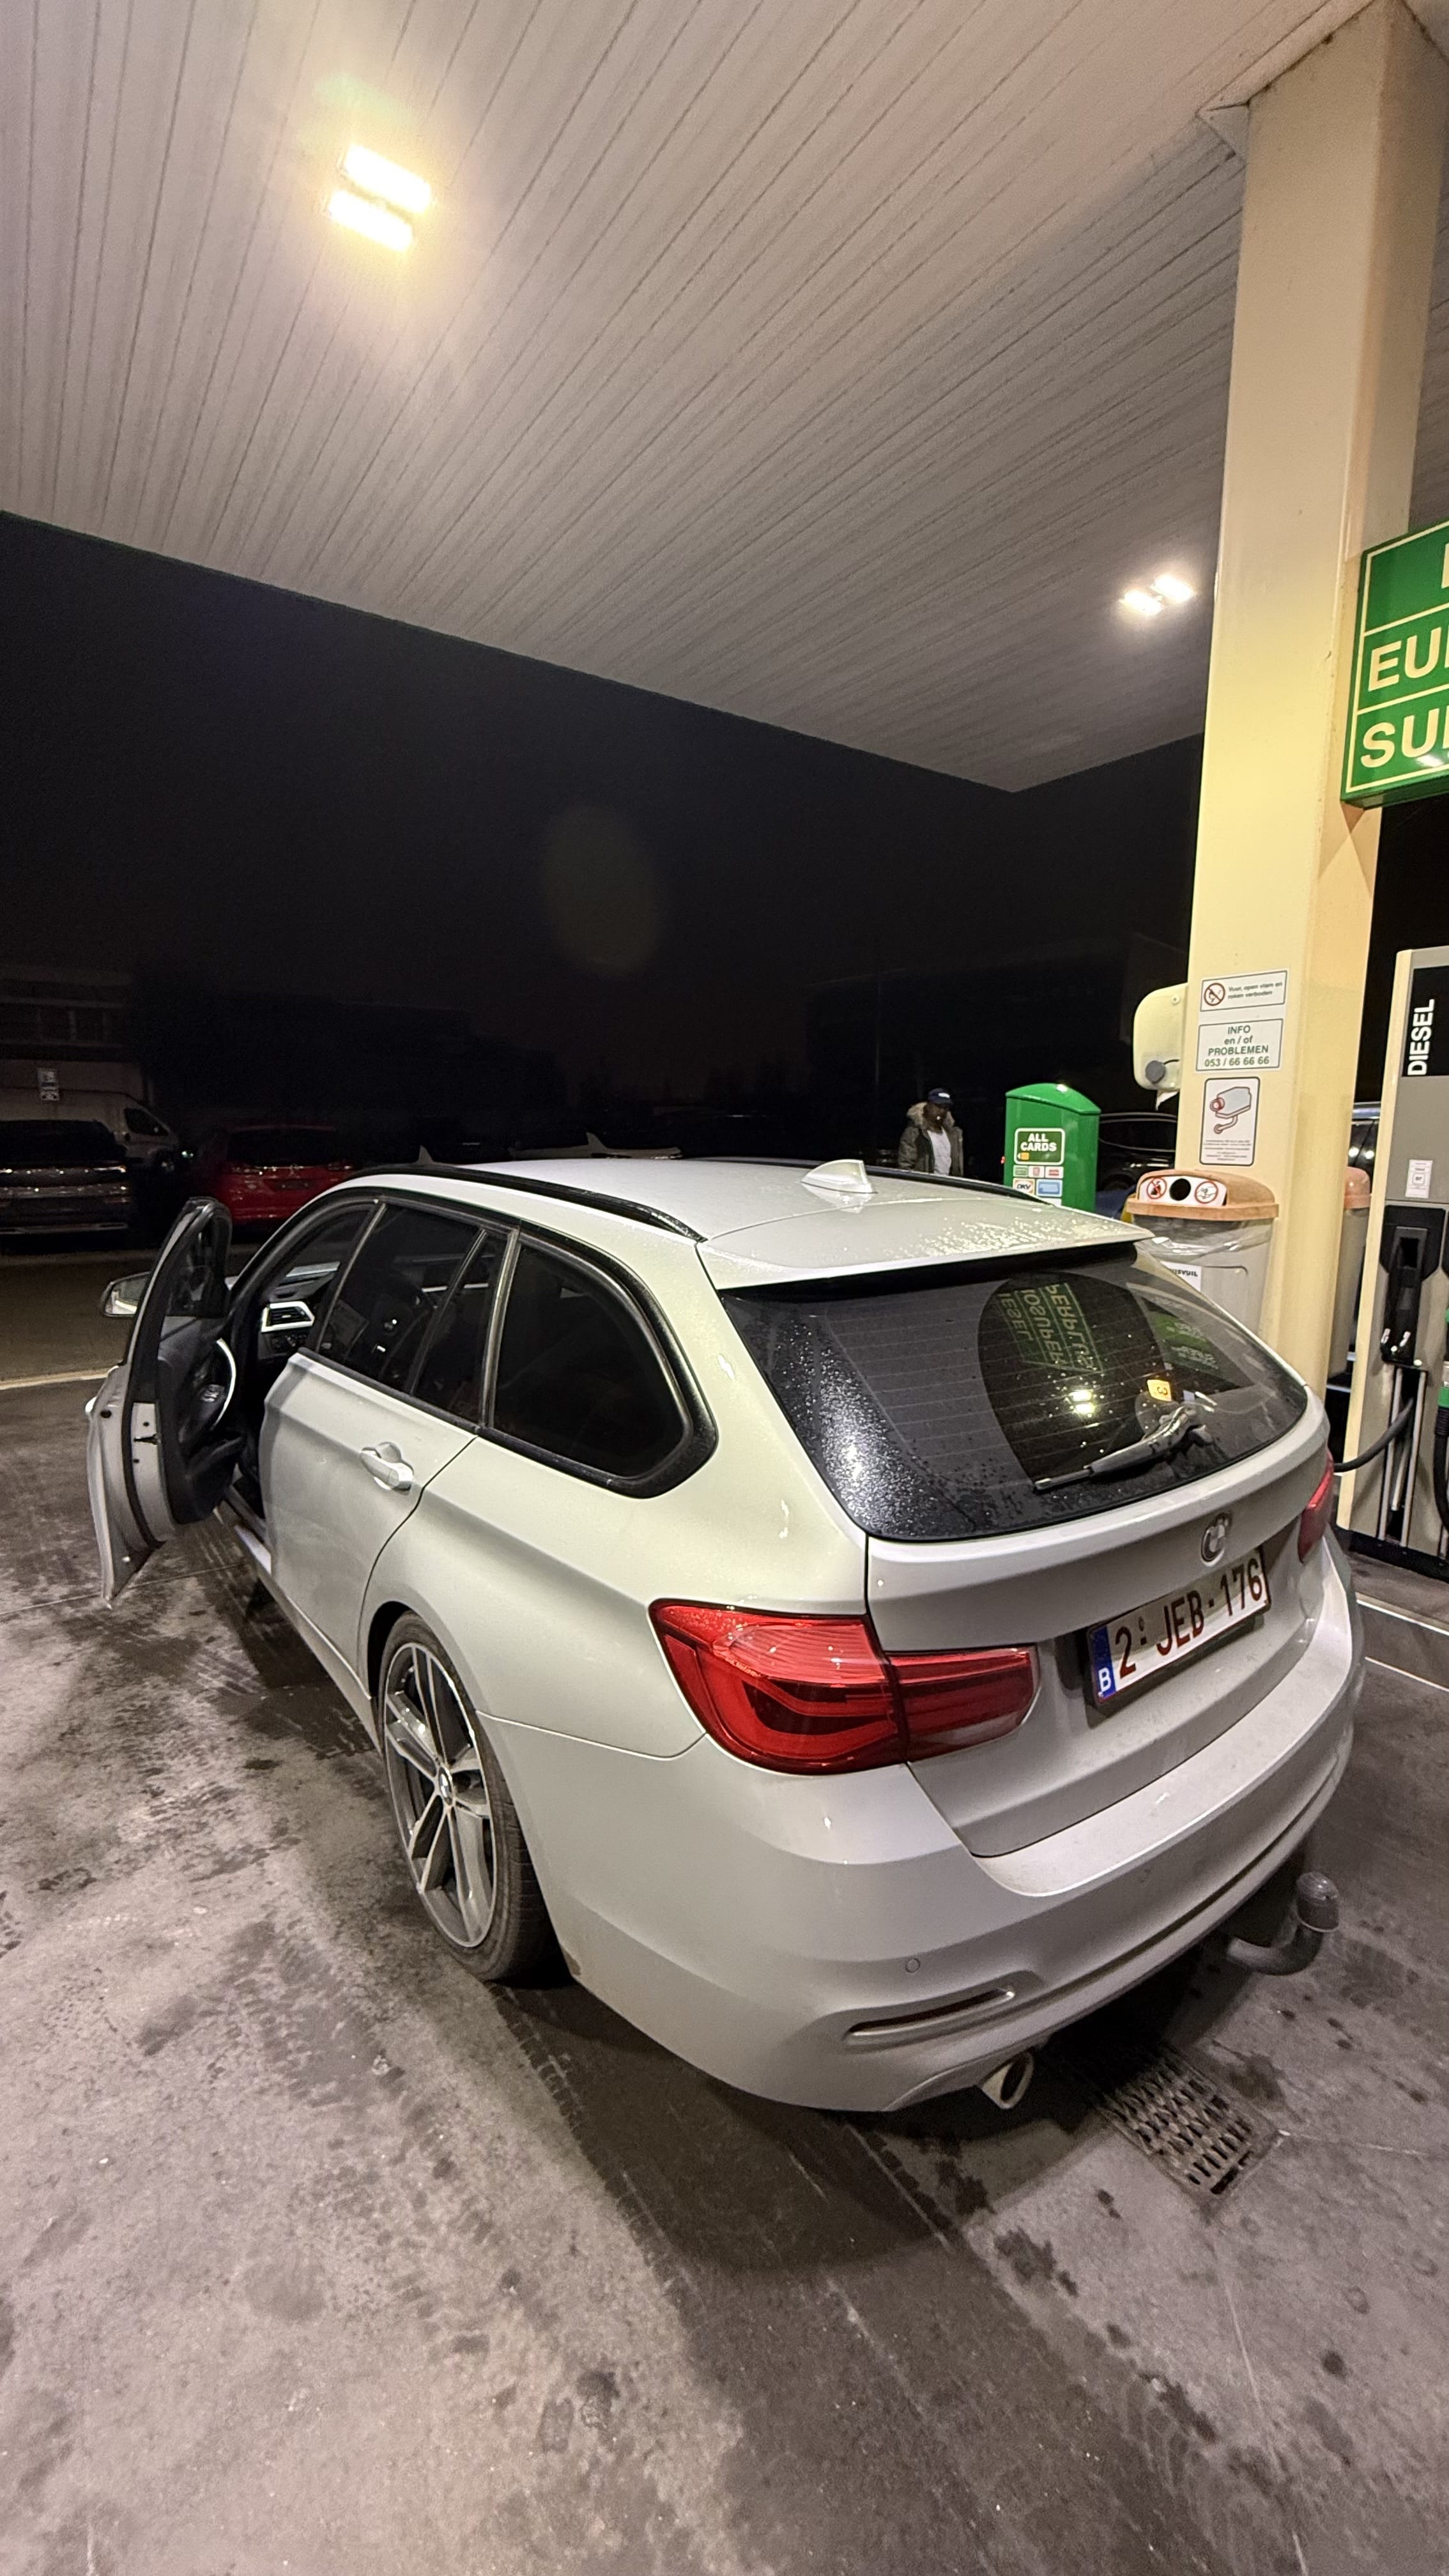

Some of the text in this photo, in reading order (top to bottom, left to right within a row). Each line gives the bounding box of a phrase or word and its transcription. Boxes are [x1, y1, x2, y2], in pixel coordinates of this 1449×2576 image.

[1368, 624, 1449, 691] EU
[1361, 707, 1449, 768] SU
[1227, 1025, 1251, 1034] INFO
[1237, 1036, 1242, 1045] /
[1243, 1034, 1254, 1044] of
[1407, 999, 1435, 1075] DIESEL
[1208, 1045, 1269, 1056] PROBLEMEN
[1204, 1055, 1269, 1067] 053 / 66 66 66
[1027, 1133, 1049, 1142] ALL
[1020, 1142, 1057, 1151] CARDS
[1098, 1667, 1112, 1692] B
